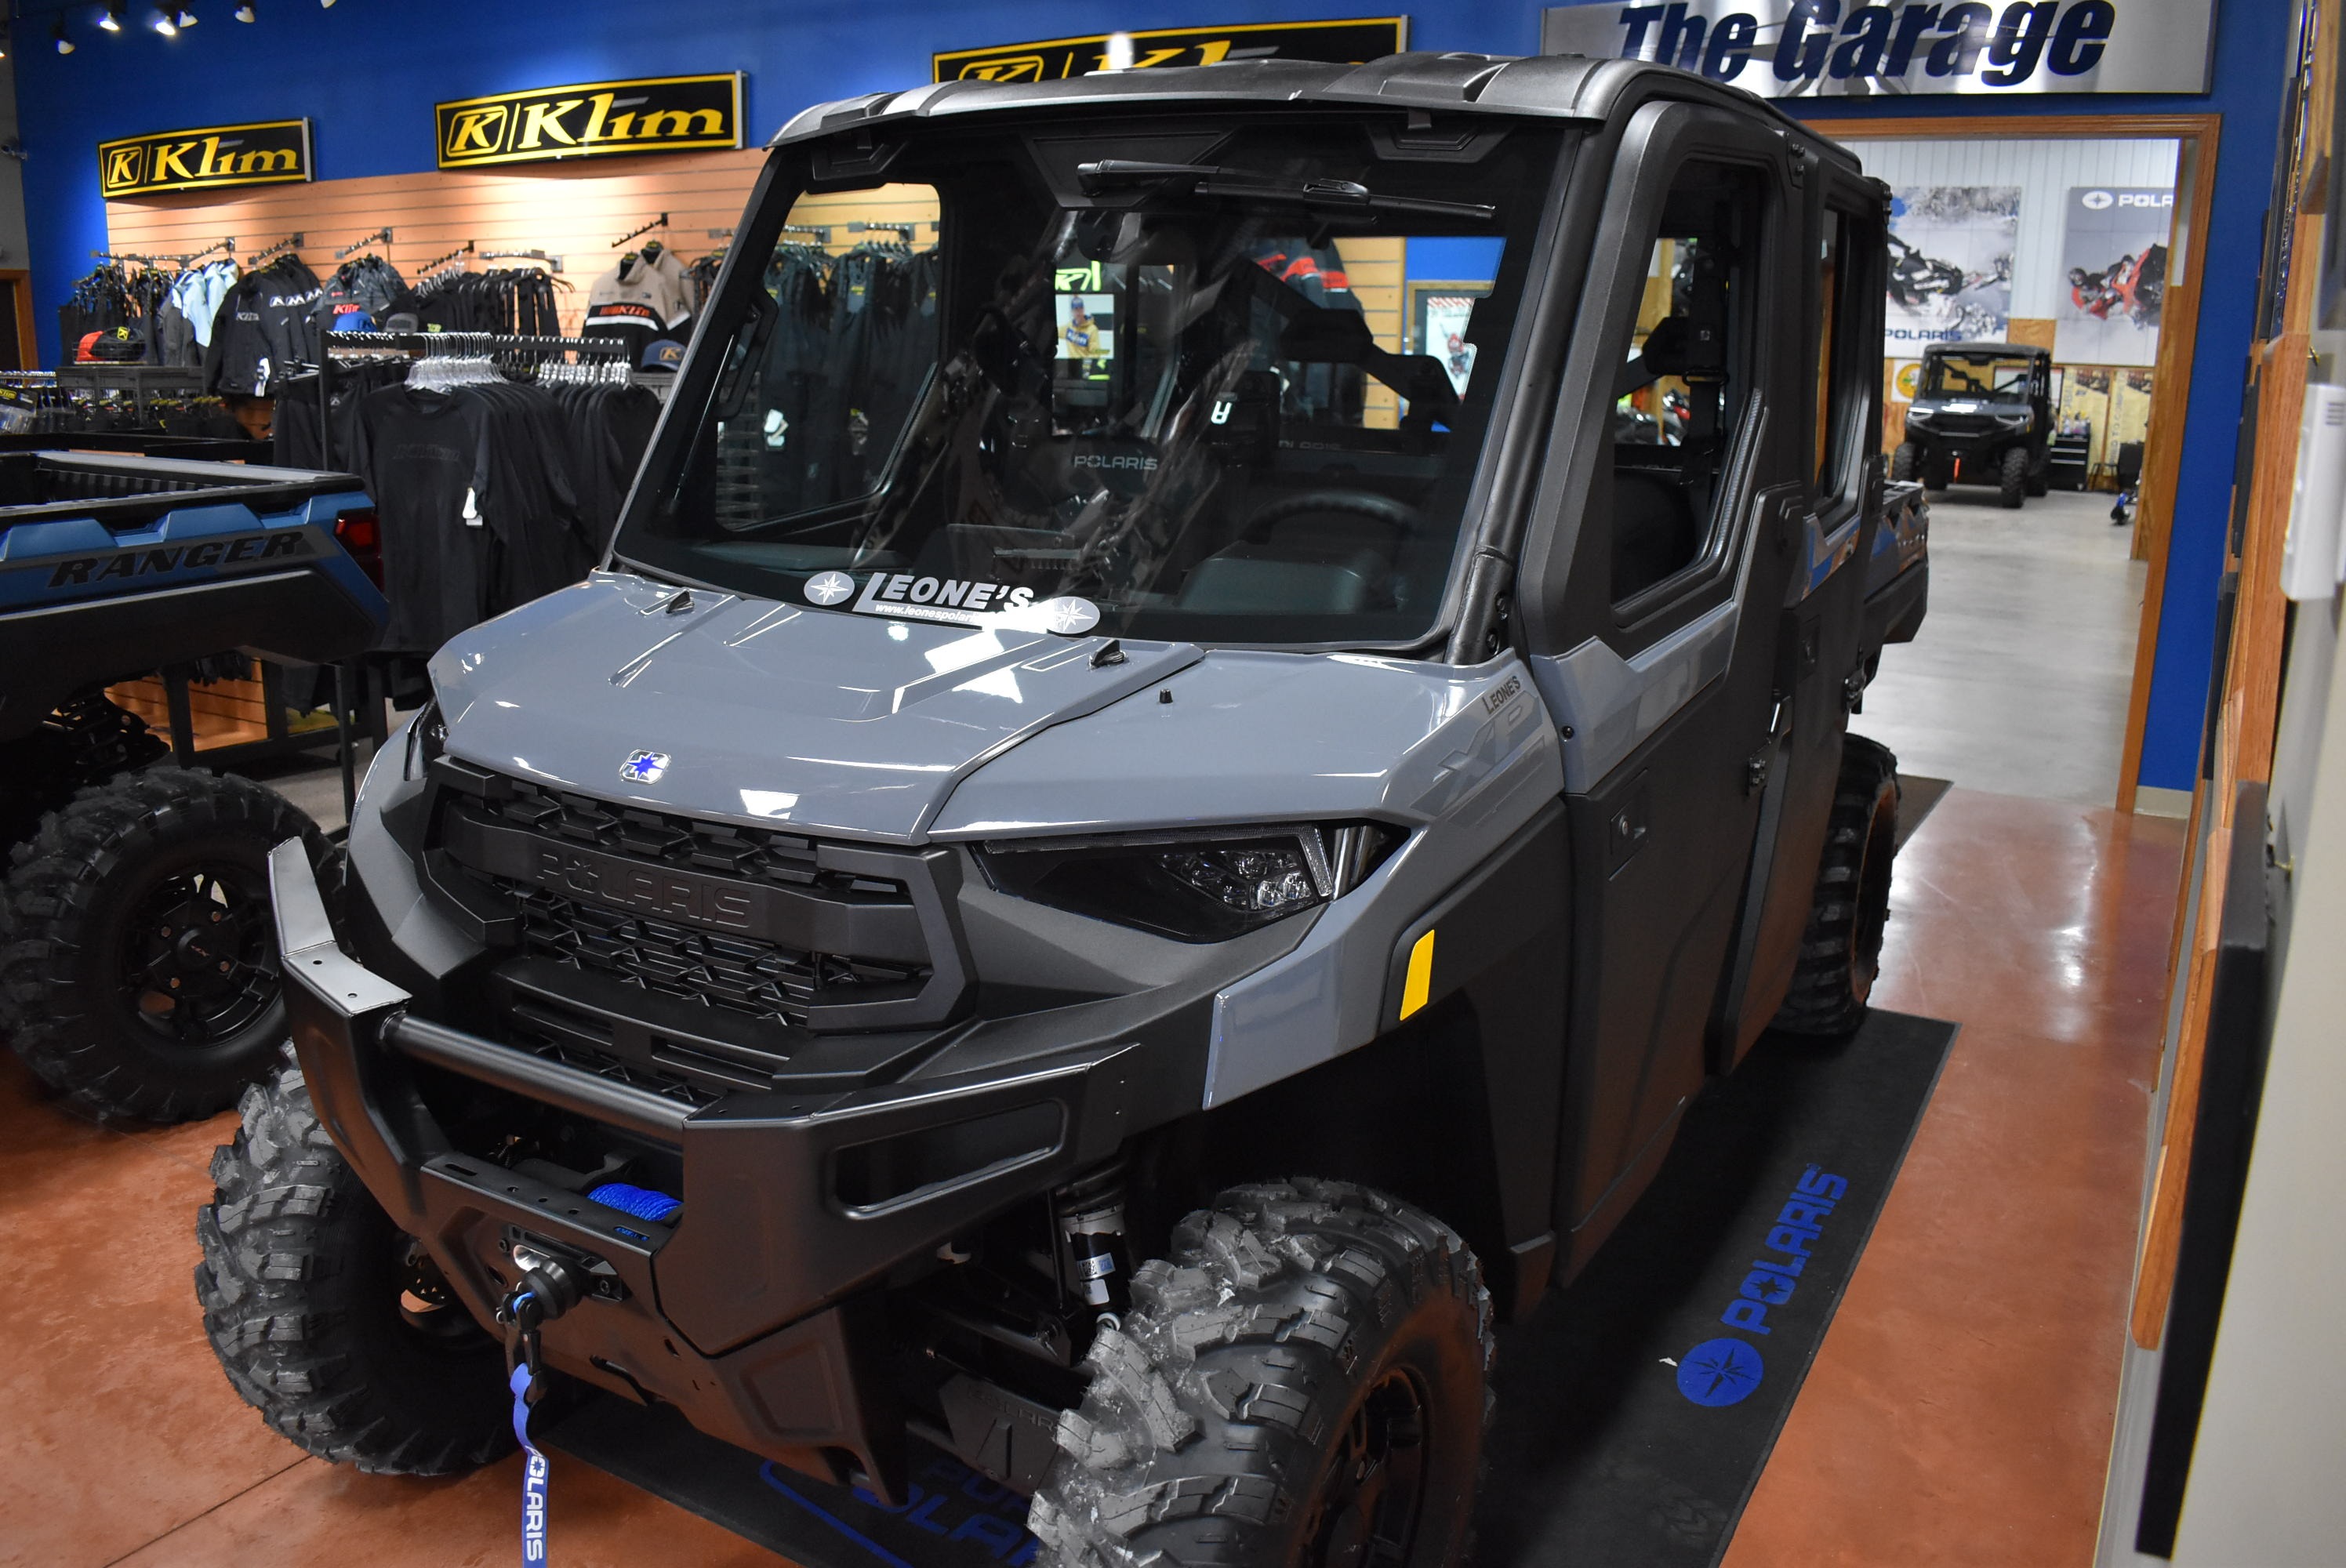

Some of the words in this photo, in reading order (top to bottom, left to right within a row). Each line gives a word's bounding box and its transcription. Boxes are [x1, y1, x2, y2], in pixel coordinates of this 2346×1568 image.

[1618, 2, 1758, 82] The
[1772, 0, 2116, 88] Garage
[518, 93, 725, 149] Klim
[151, 136, 299, 182] Klim
[1073, 455, 1158, 470] POLARIS
[48, 532, 305, 588] RANGER
[536, 852, 753, 929] POLARIS
[1720, 1168, 1849, 1336] POLARIS
[525, 1446, 547, 1562] POLARIS
